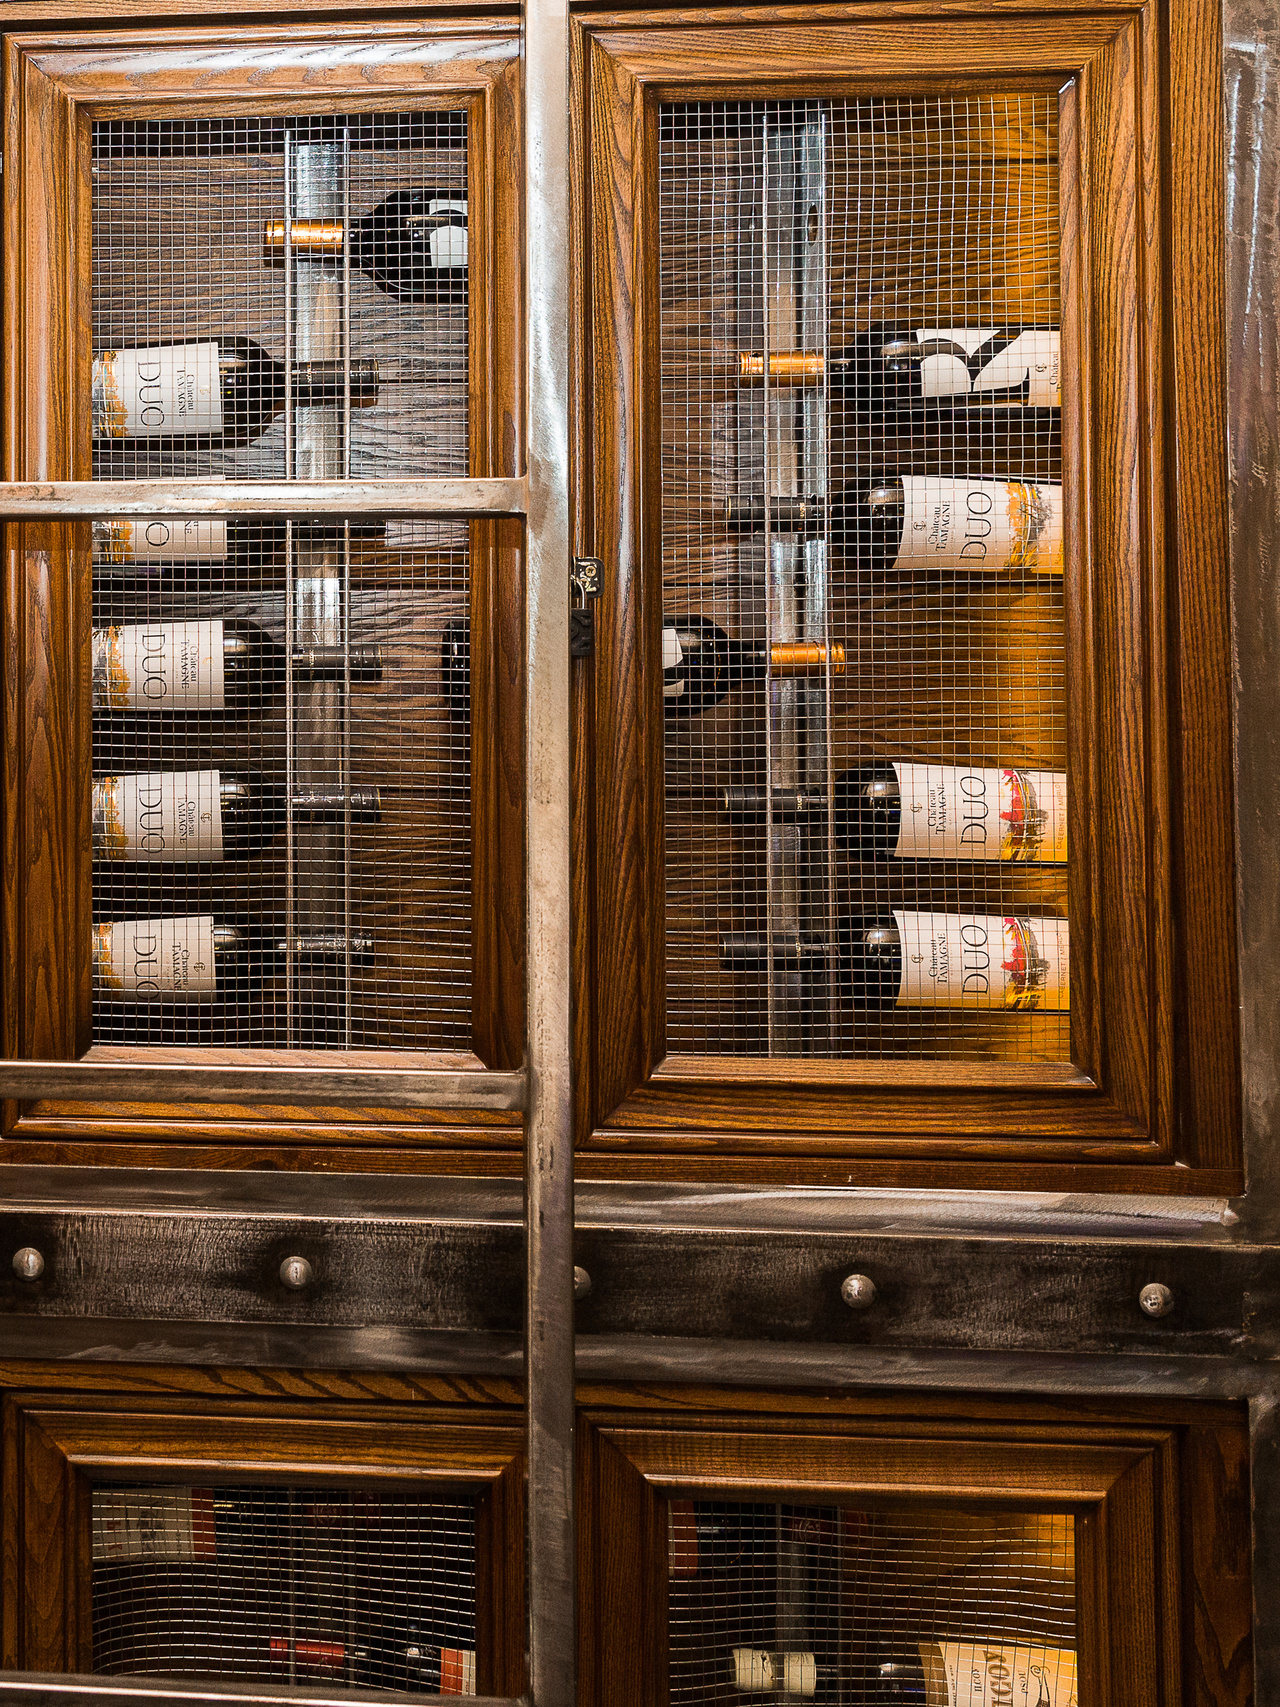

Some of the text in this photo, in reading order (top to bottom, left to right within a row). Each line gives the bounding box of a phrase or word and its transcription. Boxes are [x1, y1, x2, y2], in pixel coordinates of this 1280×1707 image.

[137, 362, 165, 427] DUO
[927, 506, 941, 545] Château
[935, 501, 951, 551] TAMAGNE
[958, 491, 993, 561] DUO
[142, 634, 167, 699] DUO
[181, 640, 190, 689] TAMAGNE
[139, 788, 165, 854] DUO
[177, 795, 187, 844] TAMAGNE
[187, 801, 196, 837] Château
[935, 784, 946, 834] TAMAGNE
[960, 776, 988, 845] DUO
[133, 934, 160, 1001] DUO
[937, 933, 948, 984] TAMAGNE
[960, 924, 990, 994] DUO
